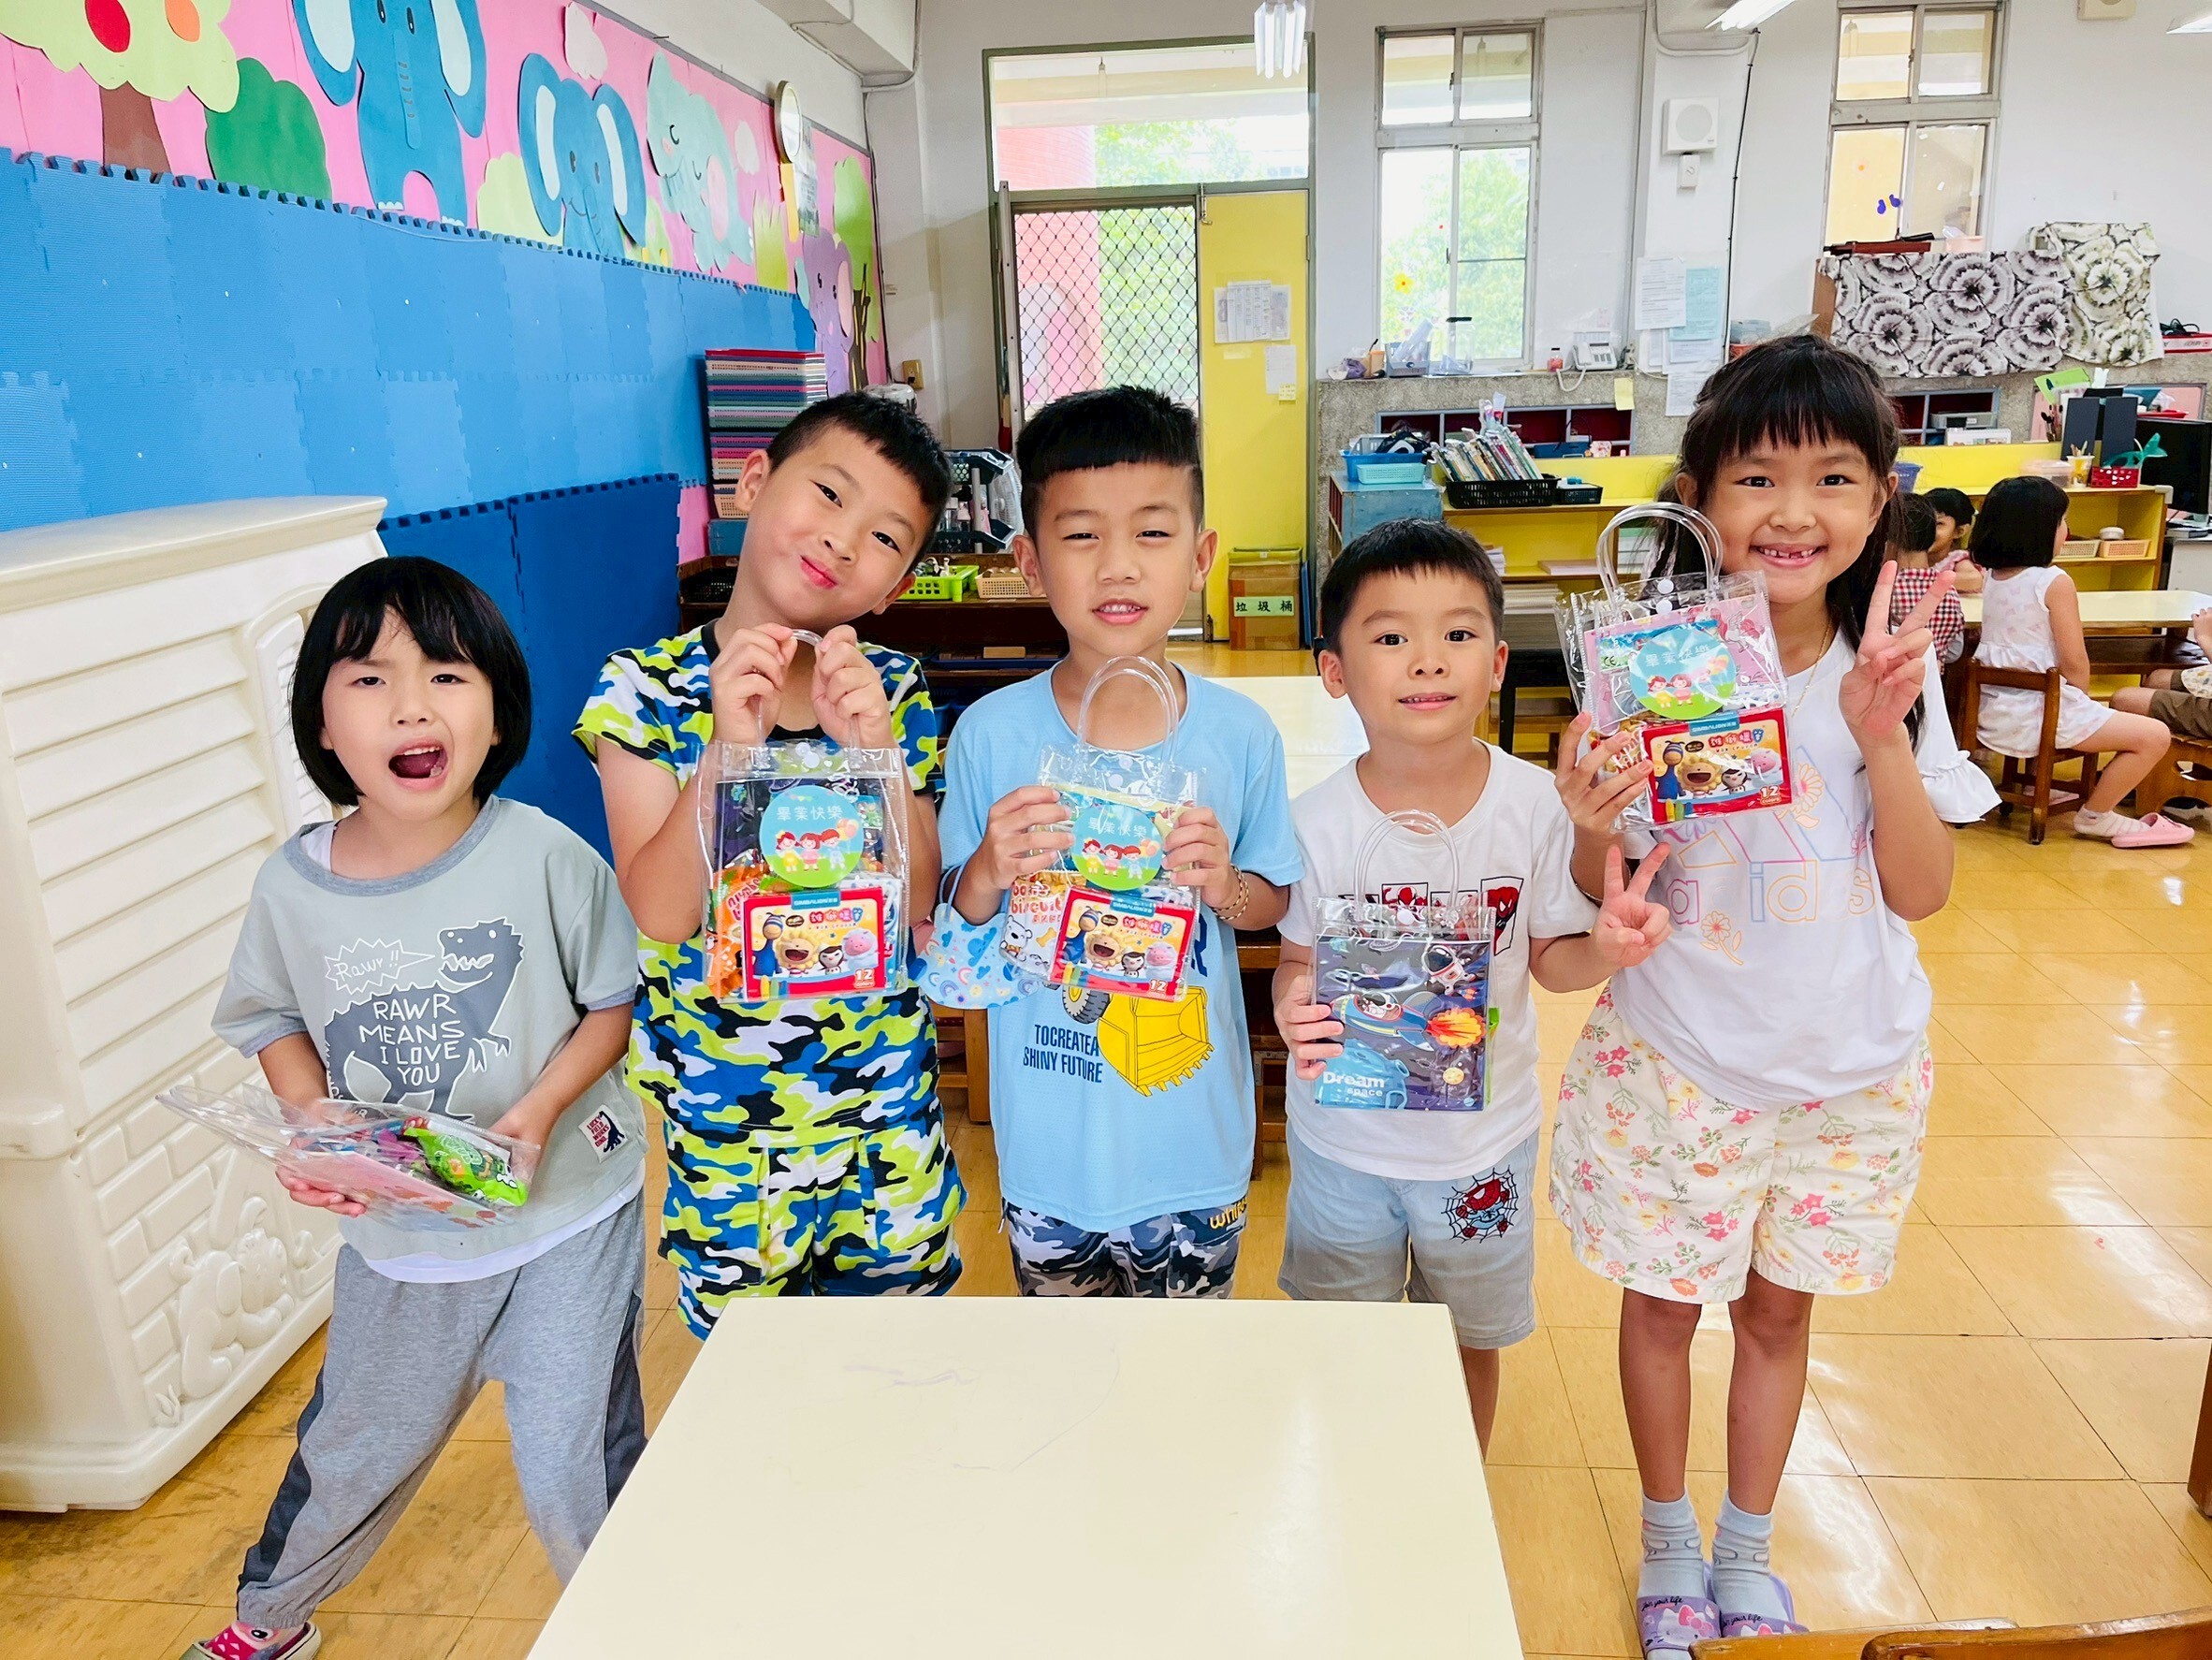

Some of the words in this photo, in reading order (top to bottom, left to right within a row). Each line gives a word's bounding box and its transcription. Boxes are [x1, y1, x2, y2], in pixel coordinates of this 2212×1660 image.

[1235, 600, 1292, 612] 垃圾桶
[1760, 785, 1779, 797] 12
[776, 805, 842, 822] 畢業快樂
[855, 968, 873, 981] 12
[1151, 979, 1167, 992] 12
[373, 993, 457, 1021] RAWR
[358, 1020, 465, 1045] MEANS
[380, 1046, 389, 1065] I
[395, 1041, 461, 1065] LOVE
[1023, 1046, 1058, 1071] SHINY
[1061, 1054, 1103, 1084] FUTURE
[397, 1062, 441, 1086] YOU
[1323, 1070, 1385, 1088] Dream
[1346, 1087, 1383, 1098] space
